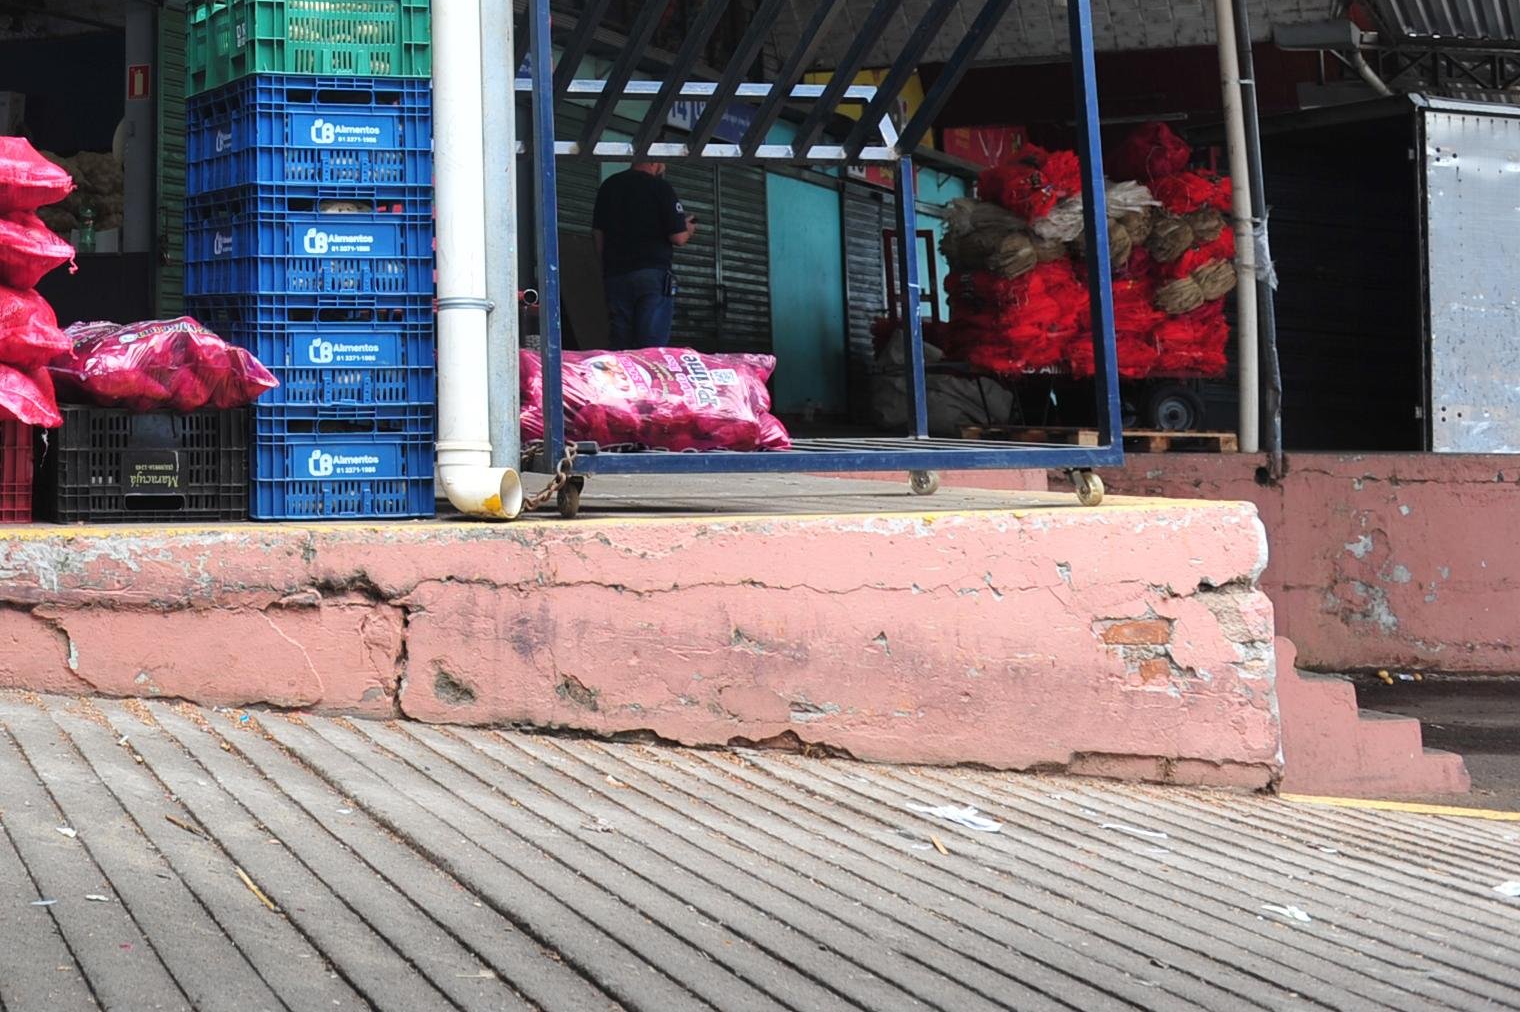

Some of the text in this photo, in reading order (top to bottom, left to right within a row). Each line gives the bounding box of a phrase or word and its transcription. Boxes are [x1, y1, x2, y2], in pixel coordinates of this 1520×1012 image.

[334, 125, 380, 135] Alimentos
[328, 234, 374, 243] Alimentos
[333, 343, 380, 353] Alimentos
[682, 354, 719, 407] Prime
[332, 455, 380, 465] Alimentos
[130, 471, 178, 488] Maracujá
